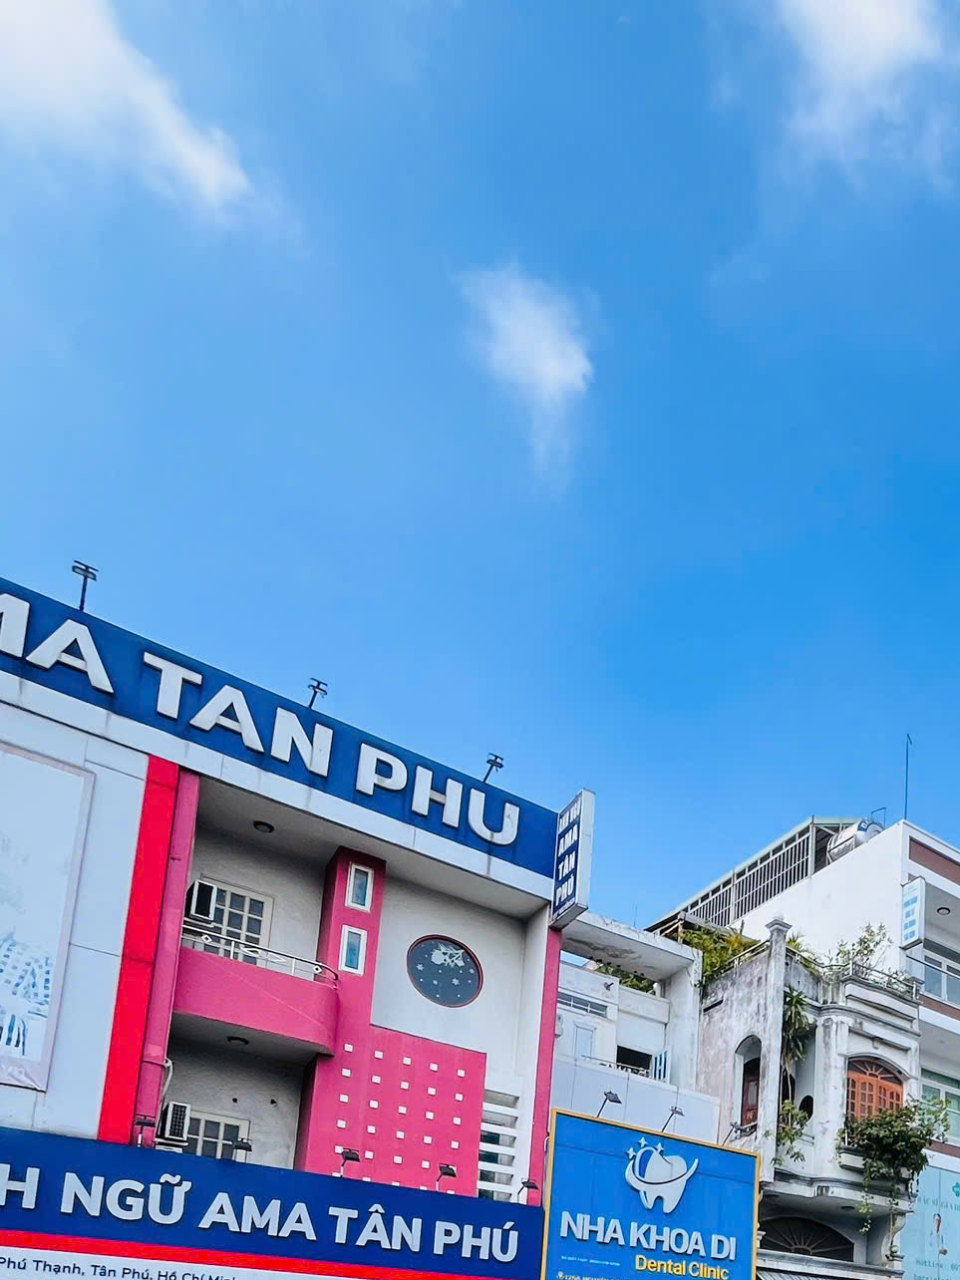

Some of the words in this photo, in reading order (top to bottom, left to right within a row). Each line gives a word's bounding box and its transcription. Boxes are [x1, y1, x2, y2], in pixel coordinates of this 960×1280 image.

[143, 651, 333, 777] TAN
[356, 743, 520, 845] PHU
[558, 823, 578, 857] AMA
[60, 1173, 193, 1225] NGỮ
[198, 1192, 317, 1240] AMA
[328, 1203, 423, 1253] TÂN
[432, 1221, 519, 1262] PHÚ
[560, 1211, 626, 1247] NHA
[629, 1221, 706, 1258] KHOA
[711, 1234, 737, 1261] DI
[32, 1260, 85, 1277] Thạnh,
[90, 1264, 116, 1277] Tân
[635, 1254, 687, 1276] Dental
[688, 1261, 730, 1280] Clinic
